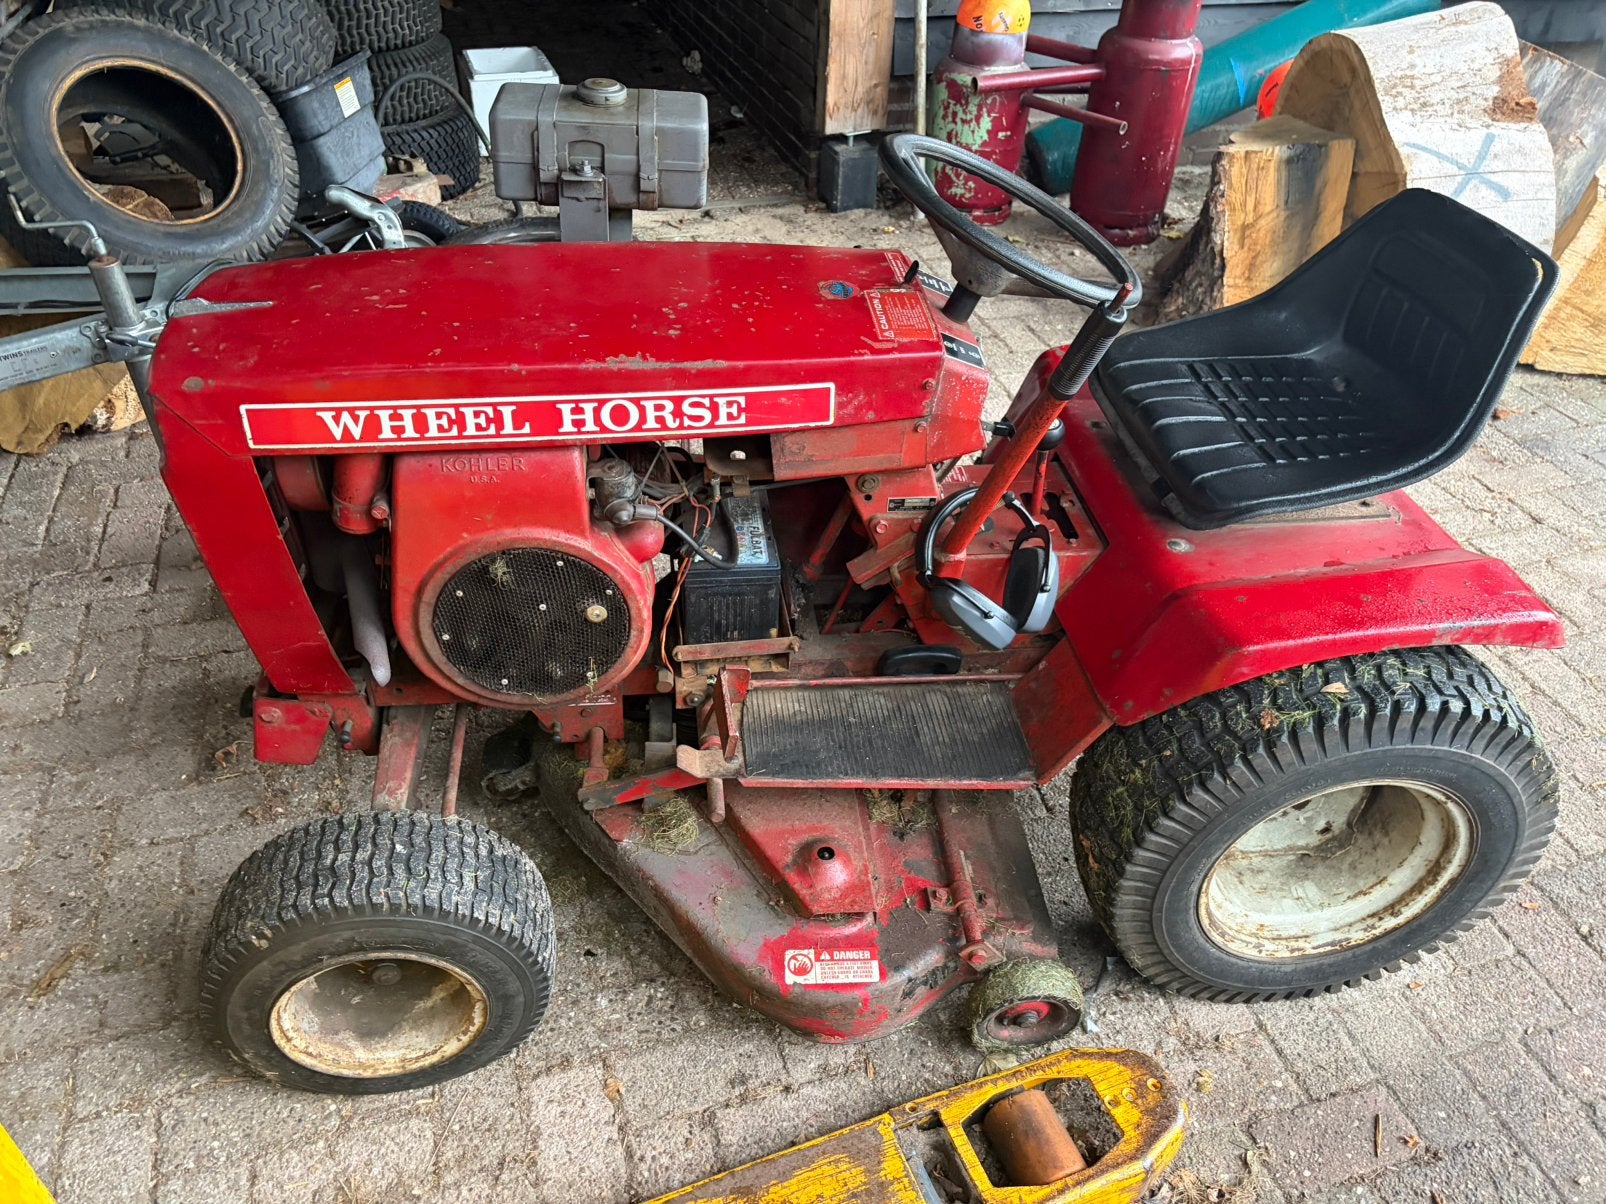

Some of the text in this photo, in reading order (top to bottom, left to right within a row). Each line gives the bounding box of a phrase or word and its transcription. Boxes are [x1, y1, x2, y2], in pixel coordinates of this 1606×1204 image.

[874, 300, 889, 330] CAUTION
[316, 396, 746, 441] WHEEL HORSE
[441, 457, 526, 473] KOHLER
[470, 475, 500, 484] U.S.A.
[749, 526, 764, 557] FULBAT
[833, 950, 871, 960] DANGER
